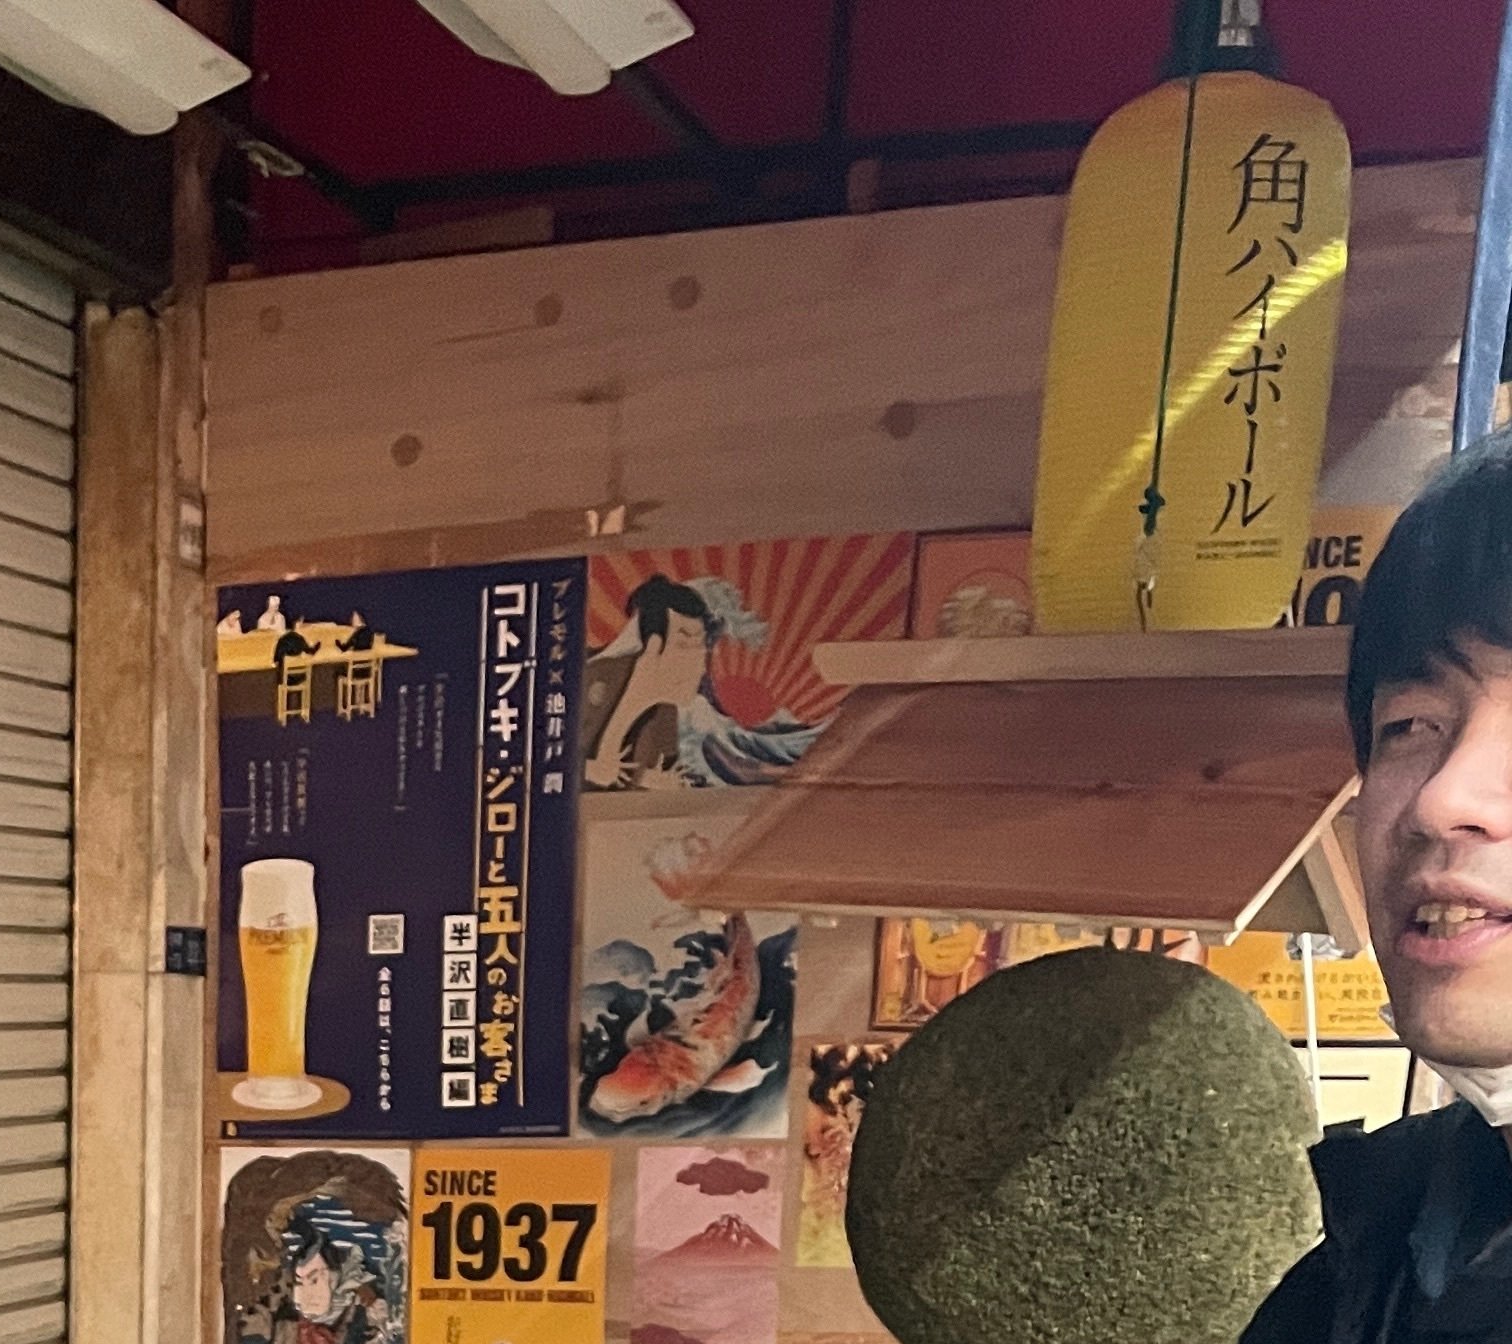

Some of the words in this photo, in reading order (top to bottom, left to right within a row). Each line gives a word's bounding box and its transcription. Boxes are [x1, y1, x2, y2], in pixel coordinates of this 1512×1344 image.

[1211, 133, 1309, 535] 角ハイボール
[424, 1170, 497, 1197] SINCE
[422, 1201, 598, 1283] 1937
